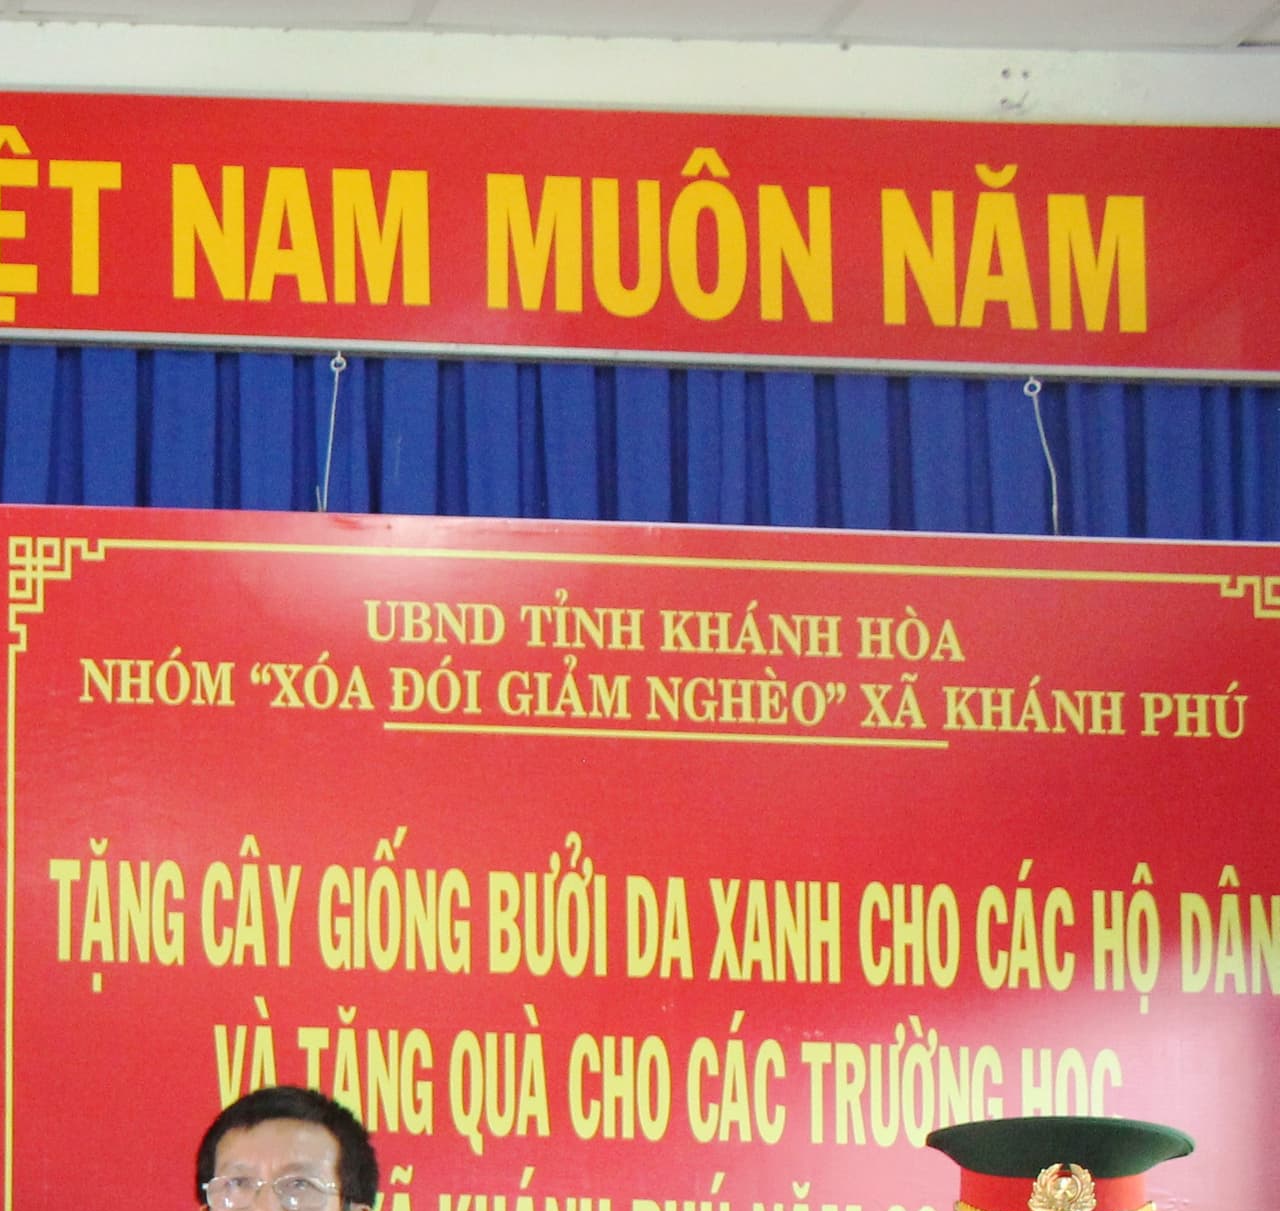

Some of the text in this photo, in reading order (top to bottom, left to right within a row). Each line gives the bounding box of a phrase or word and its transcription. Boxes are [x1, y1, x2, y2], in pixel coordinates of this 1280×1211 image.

[174, 166, 431, 306] NAM
[488, 150, 834, 322] MUÔN
[883, 166, 1147, 333] NĂM
[81, 648, 235, 707] NHÓM
[391, 656, 482, 715] ĐÓI
[498, 655, 632, 719] GIẢM
[861, 673, 927, 730] XÃ
[944, 677, 1125, 736] KHÁNH
[1142, 683, 1248, 740] PHÚ
[365, 589, 966, 663] UBND TỈNH KHÁNH HÒA
[49, 827, 1280, 1014] TẶNG CÂY GIỐNG BƯỞI DA XANH CHO CÁC HỘ DÂN
[214, 996, 278, 1110] VÀ
[450, 1005, 552, 1157] QUÀ
[569, 1034, 672, 1143] CHO
[687, 1011, 788, 1146] CÁC
[801, 1016, 1005, 1149] TRƯỜNG
